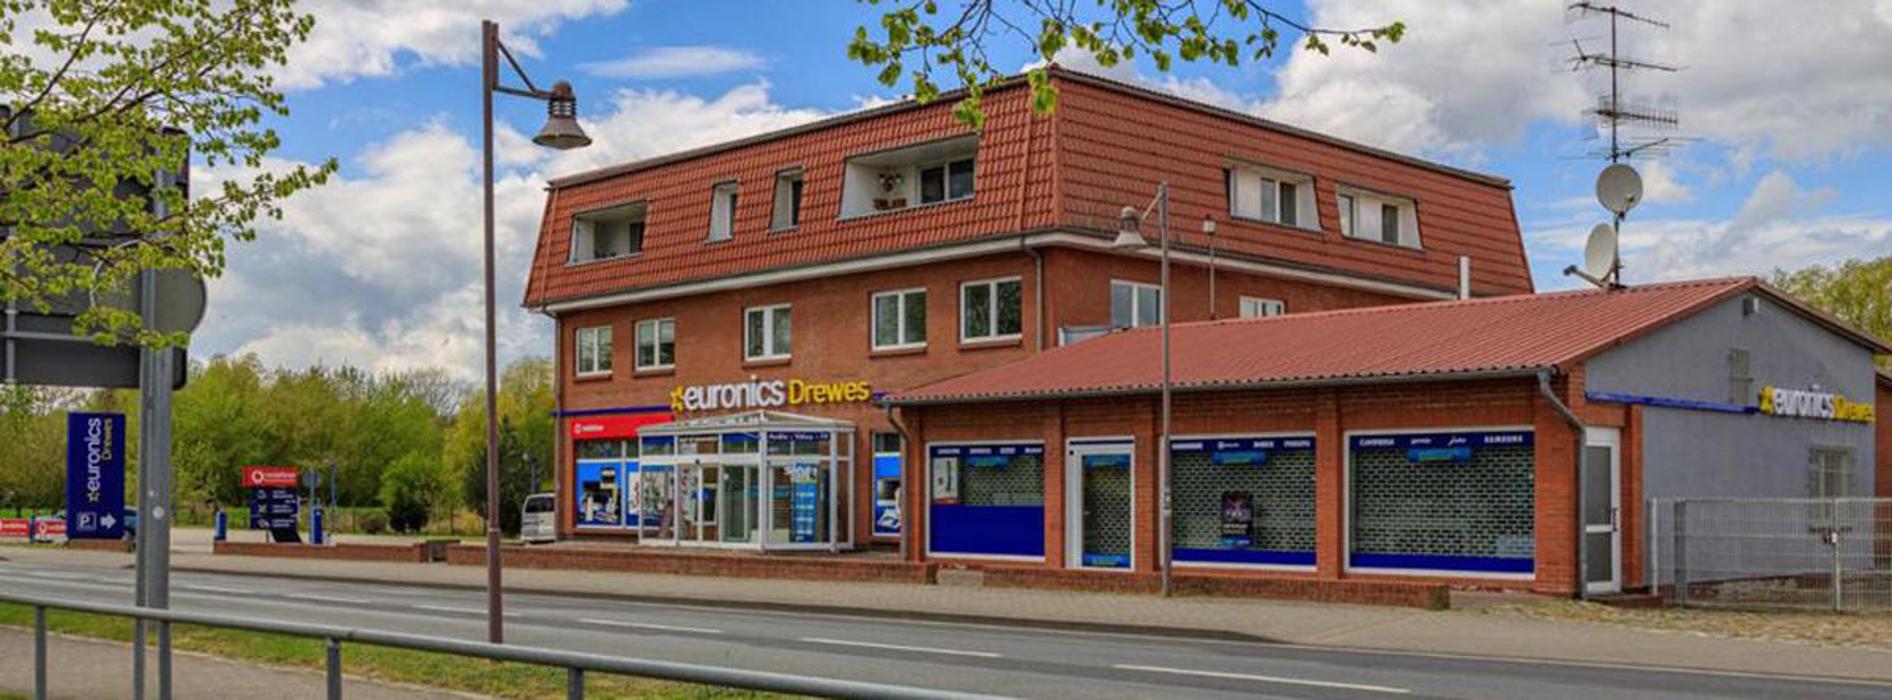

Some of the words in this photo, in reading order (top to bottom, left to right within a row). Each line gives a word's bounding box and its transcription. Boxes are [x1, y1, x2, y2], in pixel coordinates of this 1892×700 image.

[684, 375, 785, 410] euronics
[789, 379, 870, 404] Drewes
[1774, 384, 1834, 418] euronics
[85, 418, 102, 491] euronics
